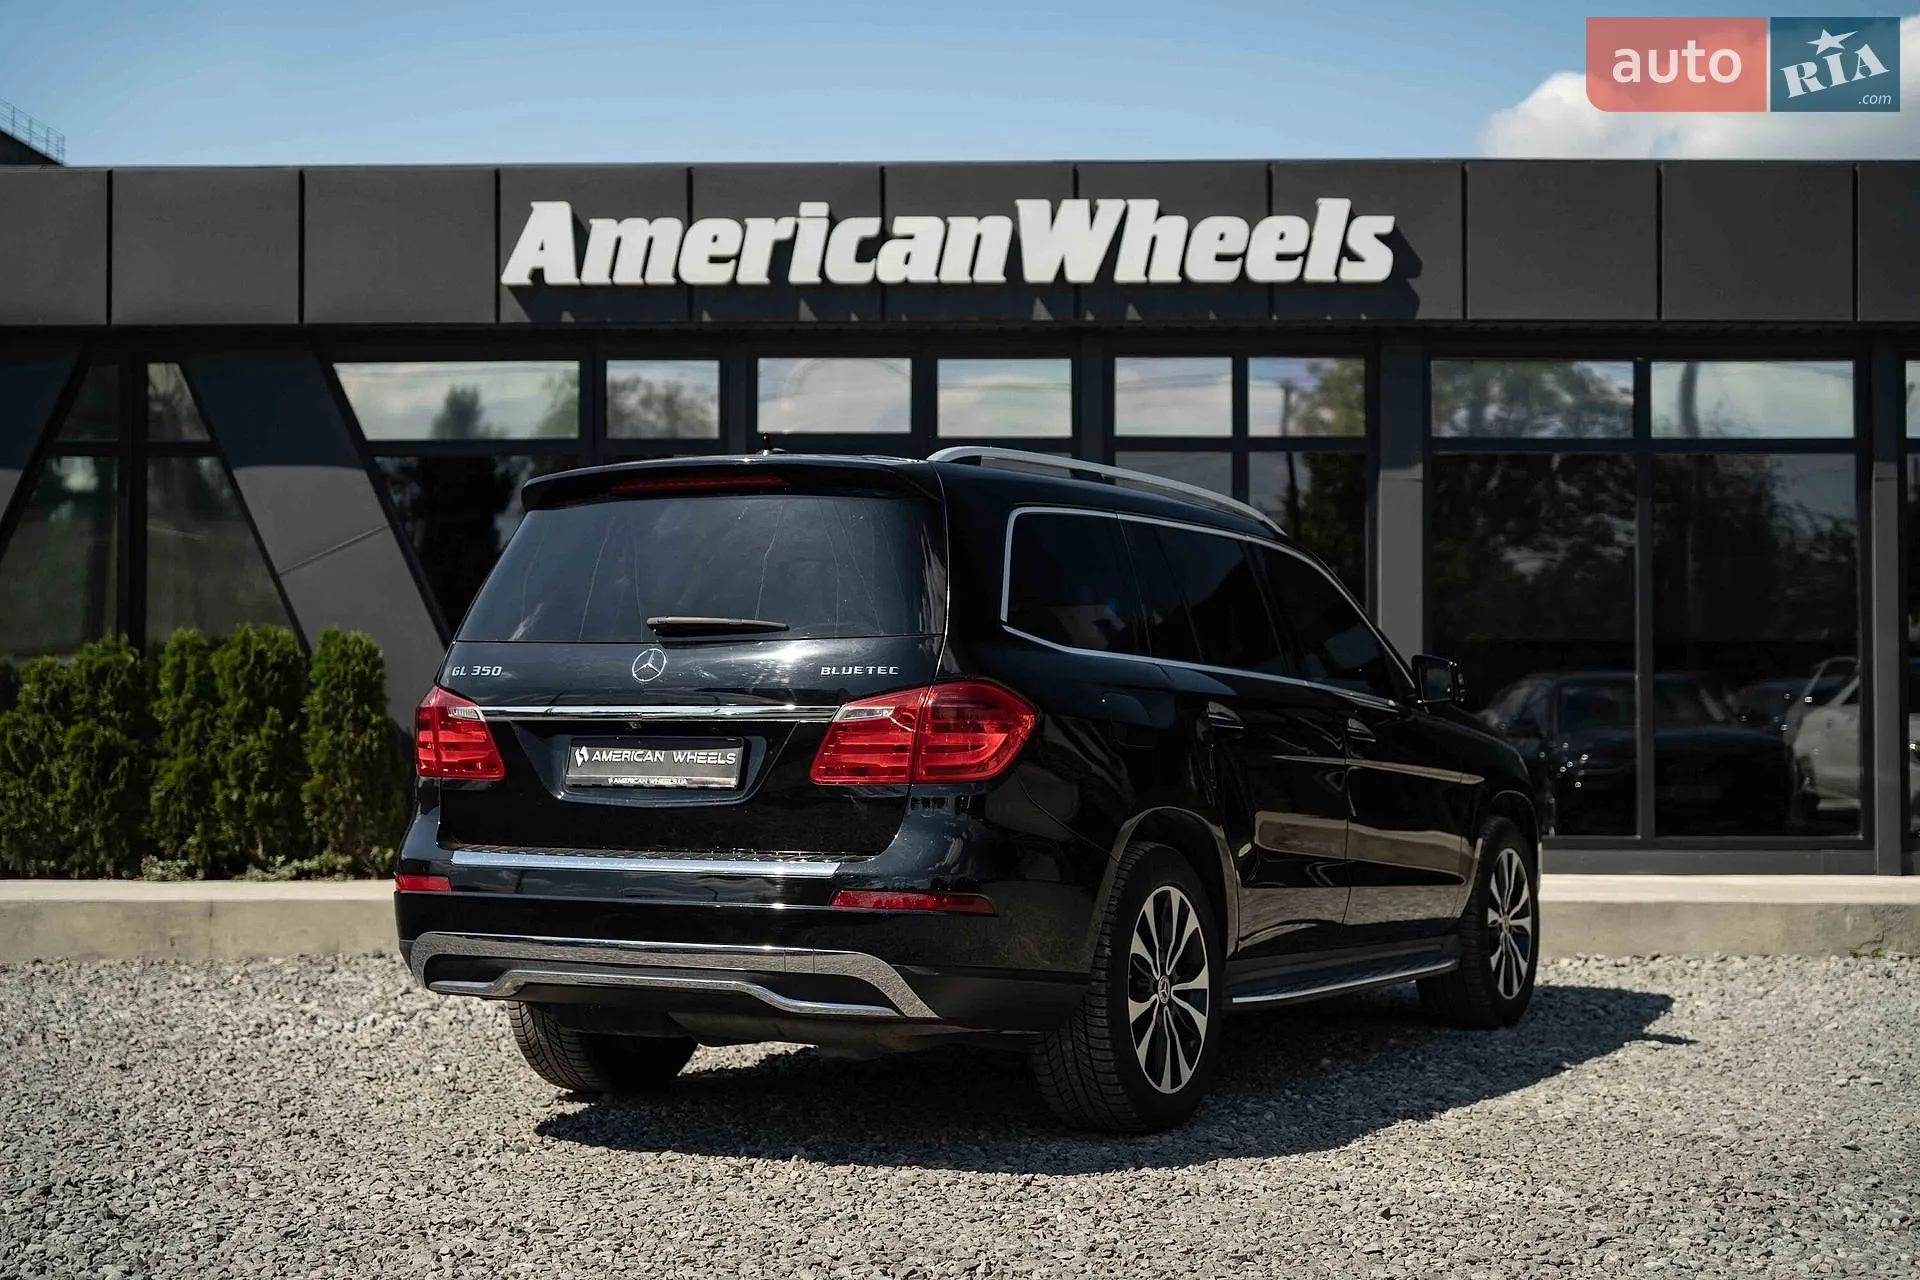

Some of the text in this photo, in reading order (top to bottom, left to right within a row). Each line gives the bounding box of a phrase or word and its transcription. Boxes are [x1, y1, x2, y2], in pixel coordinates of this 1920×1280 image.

[451, 665, 502, 676] GL 350
[820, 666, 900, 675] BLUETEC
[591, 750, 736, 765] AMERICAN WHEELS
[613, 777, 648, 785] AMERICAN
